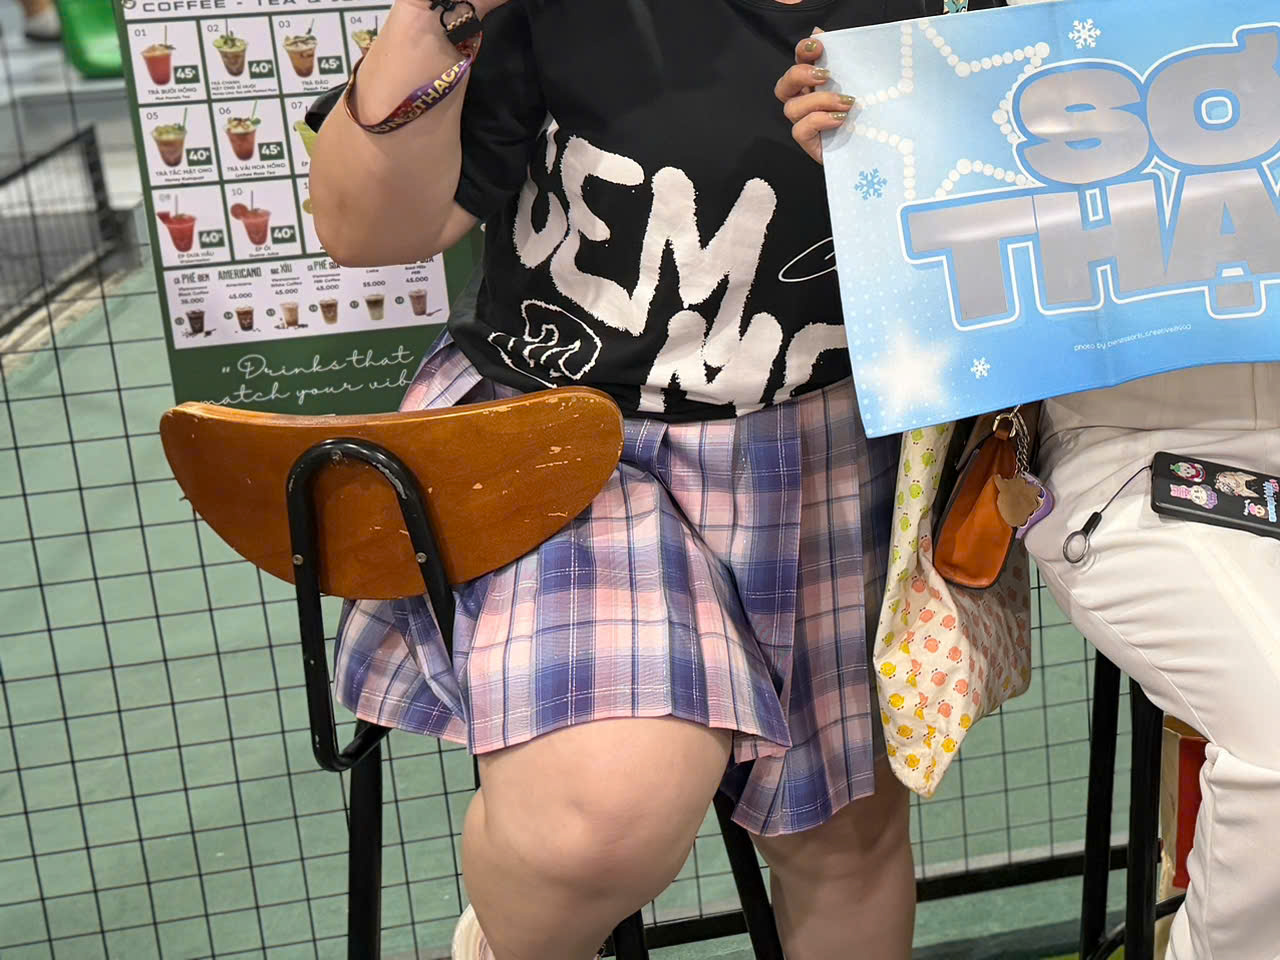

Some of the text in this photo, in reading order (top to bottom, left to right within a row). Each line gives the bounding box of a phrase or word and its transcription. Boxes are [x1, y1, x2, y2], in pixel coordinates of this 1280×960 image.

[142, 0, 226, 12] COFFEE
[350, 16, 362, 24] 04
[207, 24, 219, 32] 02
[278, 20, 291, 29] 03
[134, 29, 147, 37] 01
[291, 102, 303, 110] 07
[219, 107, 231, 115] 06
[218, 267, 262, 280] AMERICANO
[237, 354, 347, 379] Drinks
[346, 345, 414, 368] that
[296, 383, 364, 405] your
